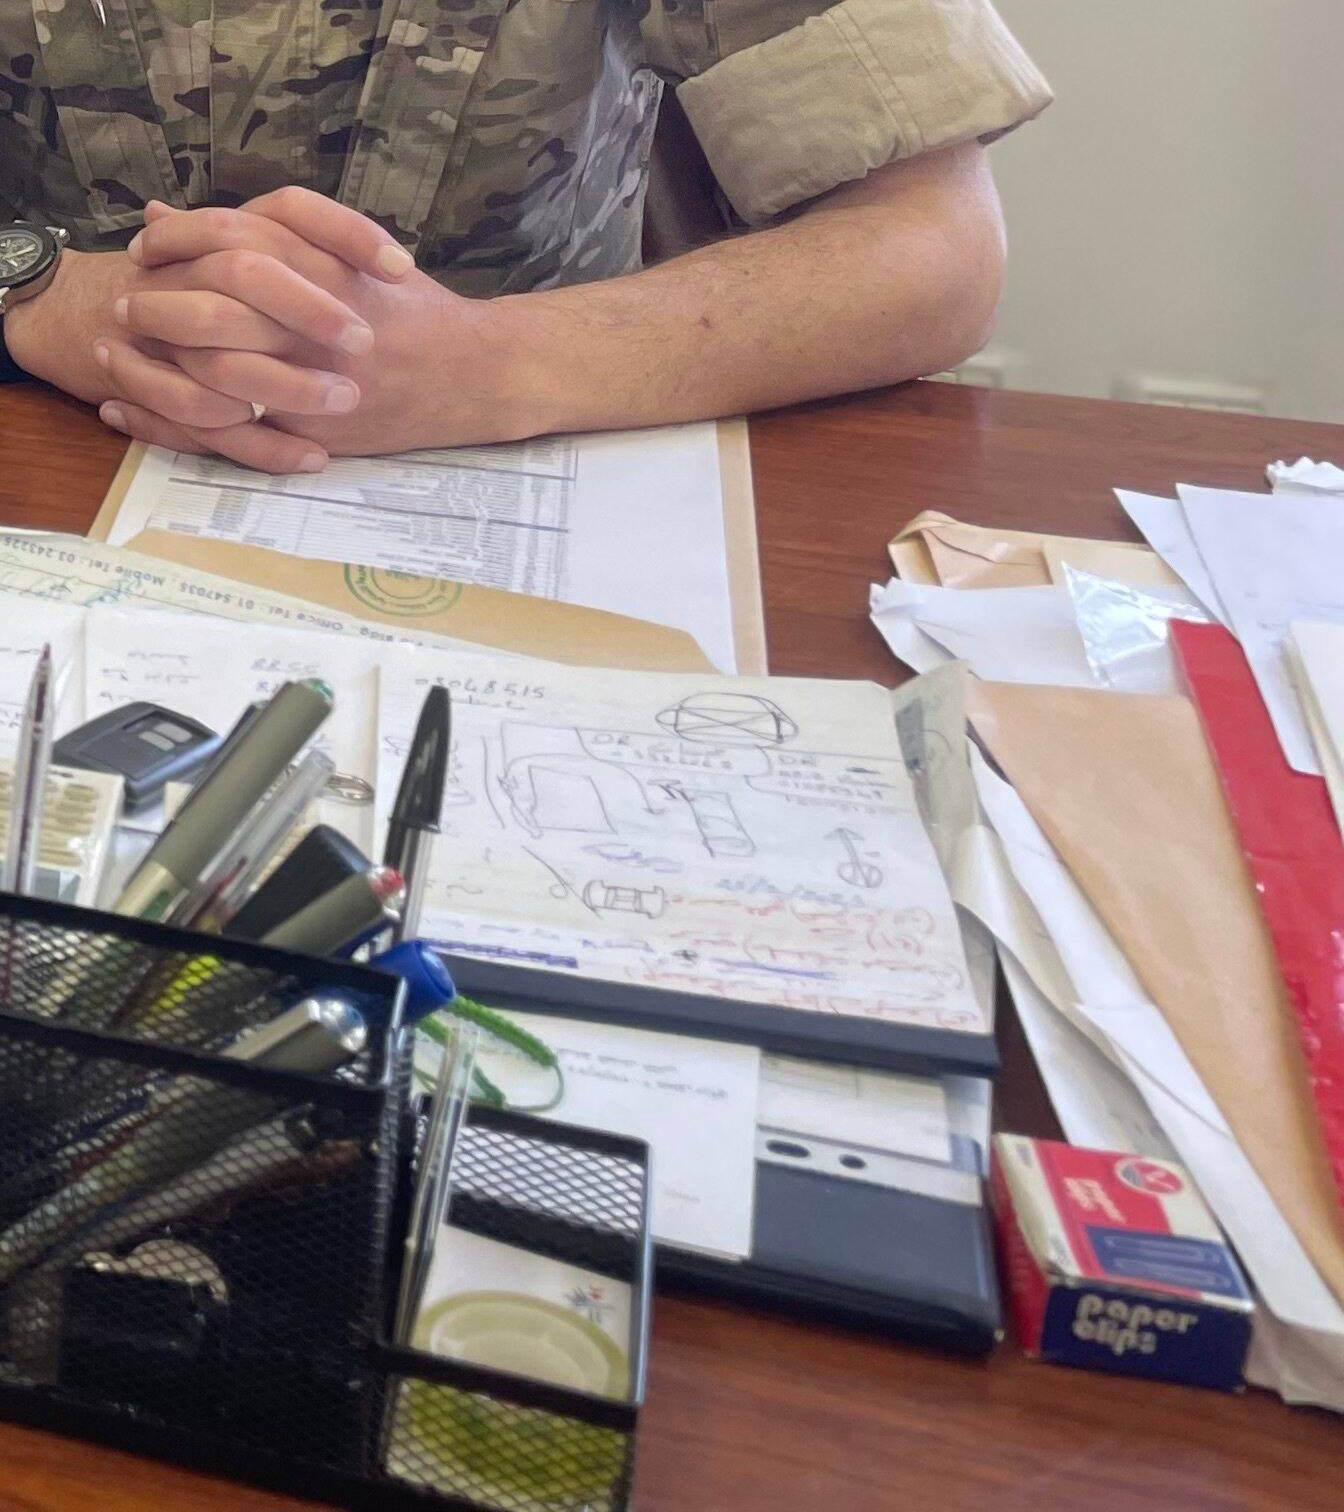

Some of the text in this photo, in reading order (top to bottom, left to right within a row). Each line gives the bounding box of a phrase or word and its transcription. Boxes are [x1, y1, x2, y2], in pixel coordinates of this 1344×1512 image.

[115, 565, 167, 586] Mobile
[180, 582, 232, 604] 547035
[297, 612, 344, 632] Office
[1074, 1294, 1200, 1334] paper
